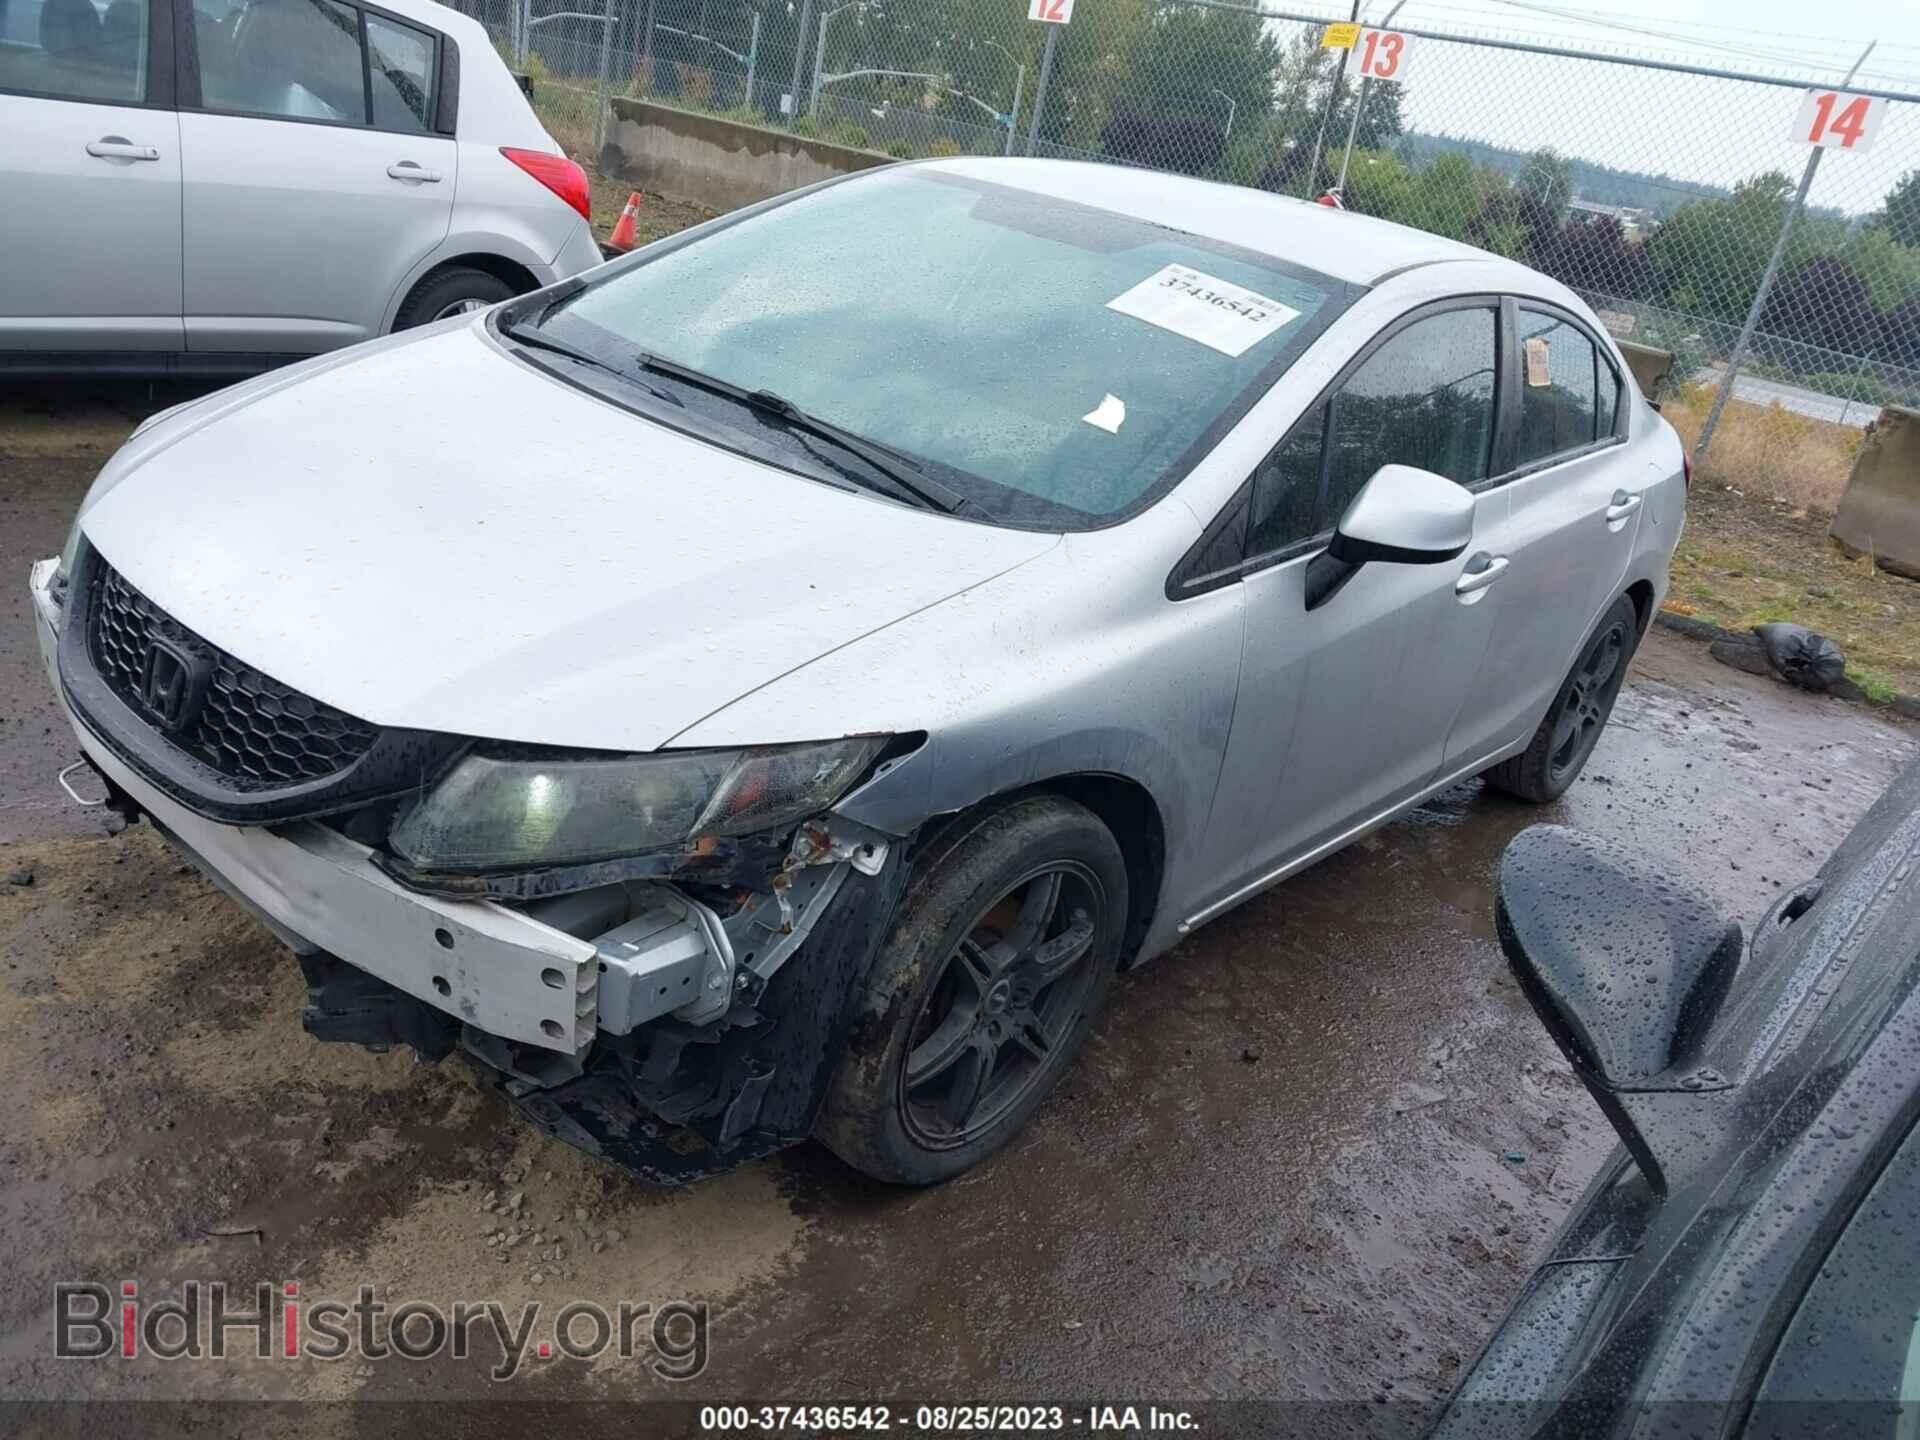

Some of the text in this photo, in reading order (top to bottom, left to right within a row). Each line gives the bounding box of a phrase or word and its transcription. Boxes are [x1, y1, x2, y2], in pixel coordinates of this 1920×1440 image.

[1038, 0, 1066, 20] 12
[1360, 31, 1404, 78] 13
[1807, 92, 1873, 148] 14
[1160, 277, 1268, 322] 37436542
